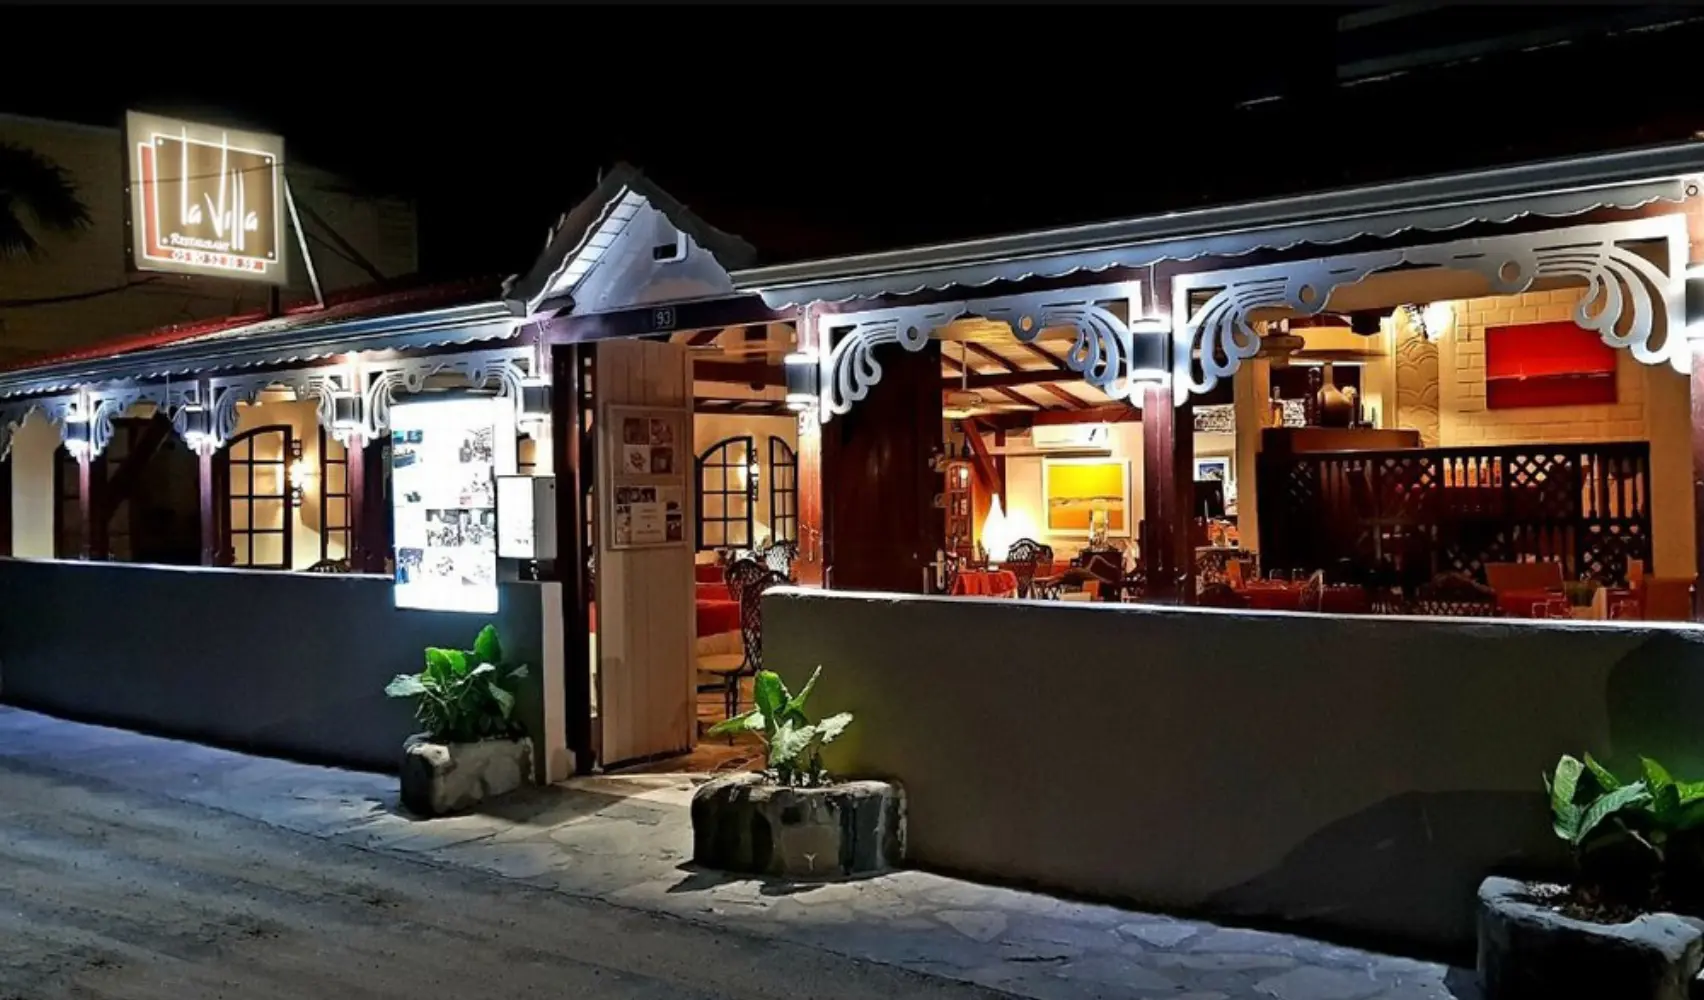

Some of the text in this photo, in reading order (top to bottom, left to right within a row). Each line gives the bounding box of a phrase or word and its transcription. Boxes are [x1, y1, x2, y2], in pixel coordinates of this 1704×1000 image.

[180, 126, 258, 251] La Villa
[656, 311, 671, 325] 93
